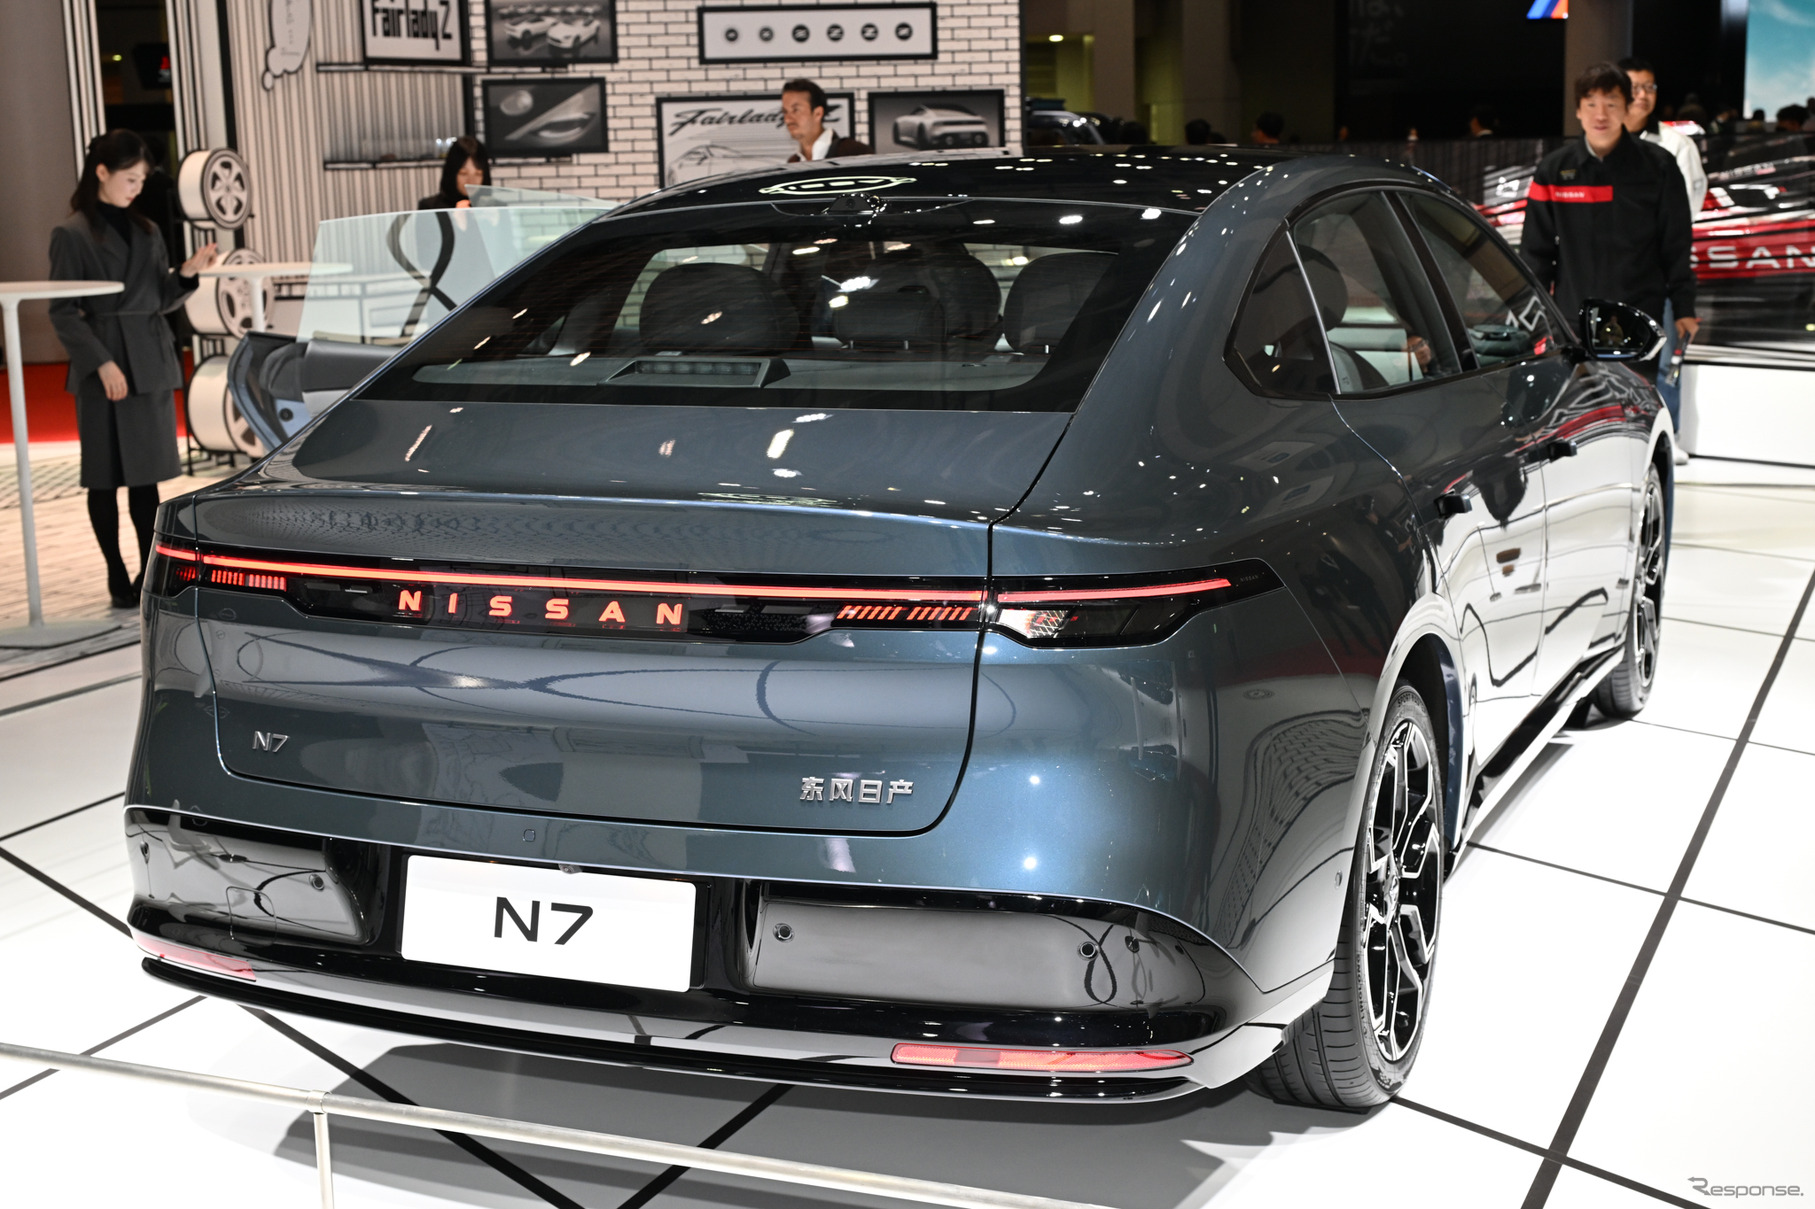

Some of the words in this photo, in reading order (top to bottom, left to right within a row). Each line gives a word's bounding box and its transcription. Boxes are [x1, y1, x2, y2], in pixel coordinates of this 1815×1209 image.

[398, 590, 683, 626] NISSAN
[252, 730, 290, 752] N7
[800, 776, 914, 804] 东风日产
[494, 896, 594, 946] N7
